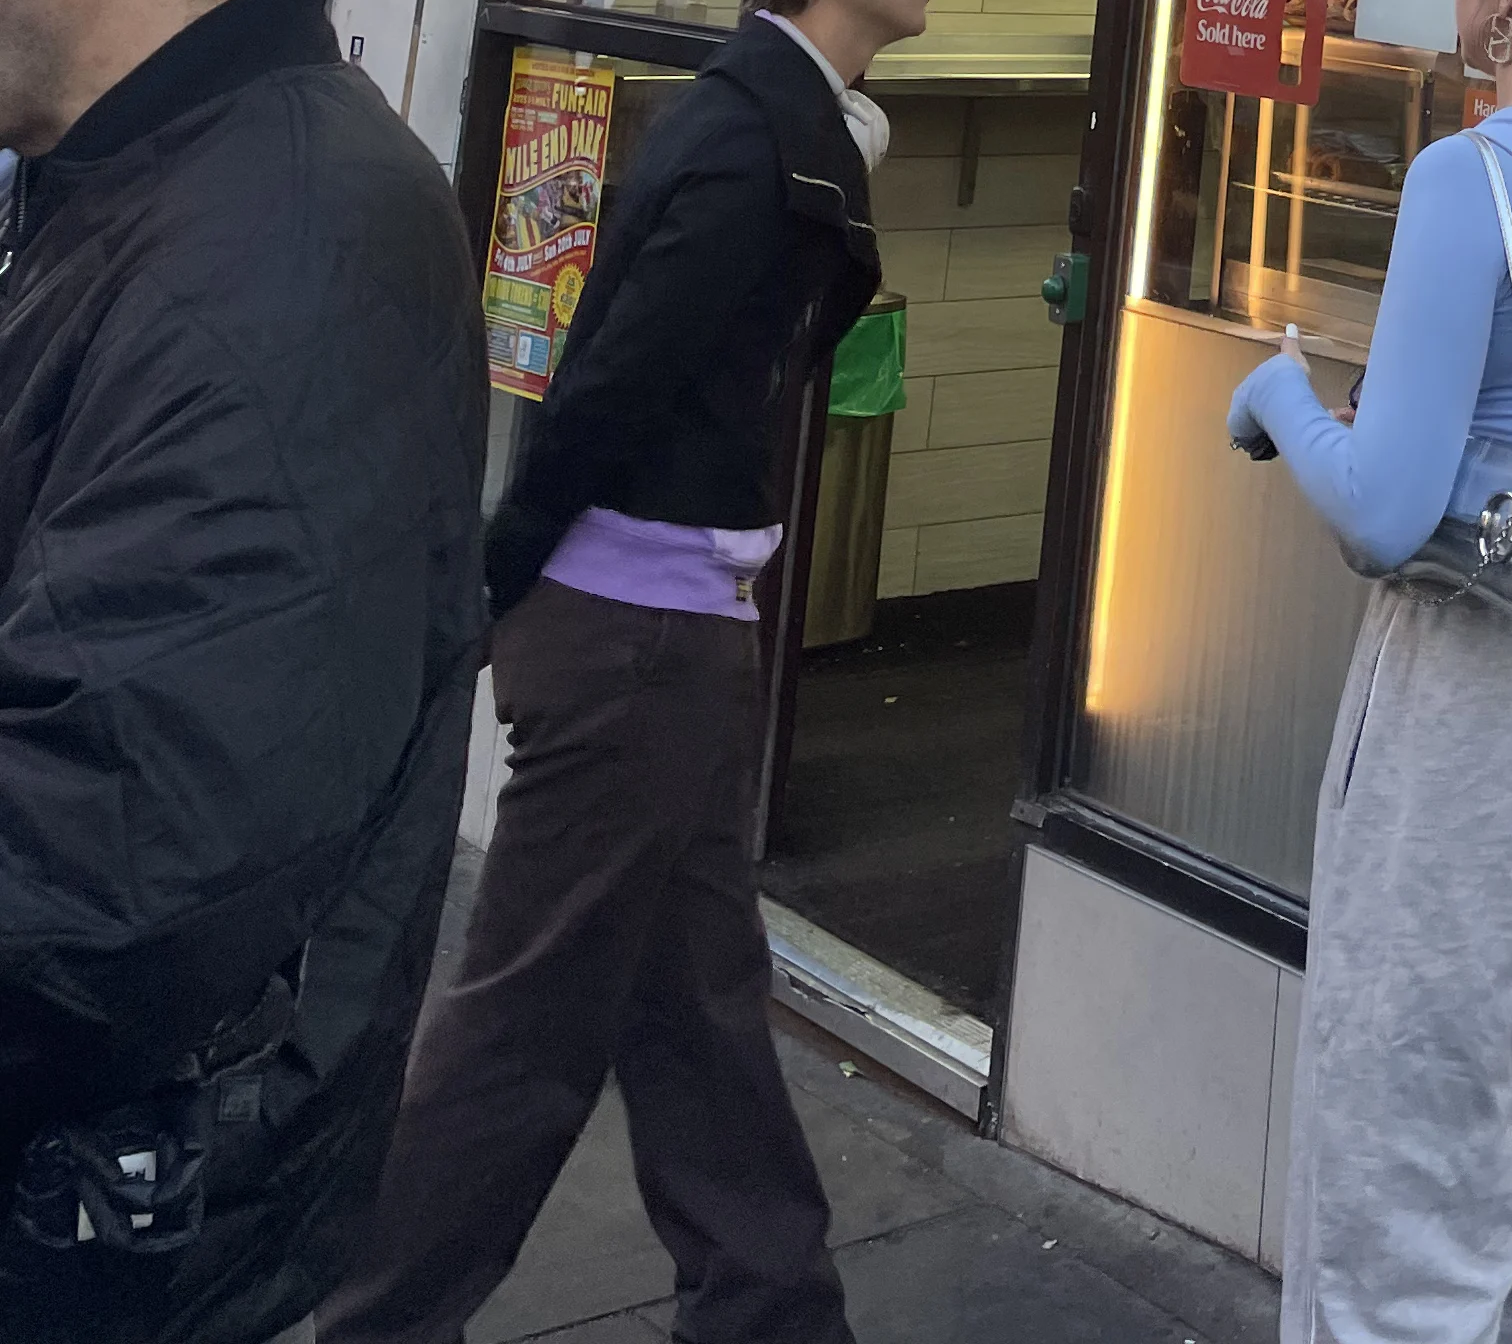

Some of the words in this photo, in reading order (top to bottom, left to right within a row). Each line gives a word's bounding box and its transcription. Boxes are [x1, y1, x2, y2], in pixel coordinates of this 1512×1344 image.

[1196, 19, 1229, 46] Sold
[1231, 25, 1266, 50] here
[552, 83, 608, 118] FUNFAIR
[504, 138, 538, 185] MILE
[541, 124, 568, 172] END
[570, 119, 604, 164] PARK
